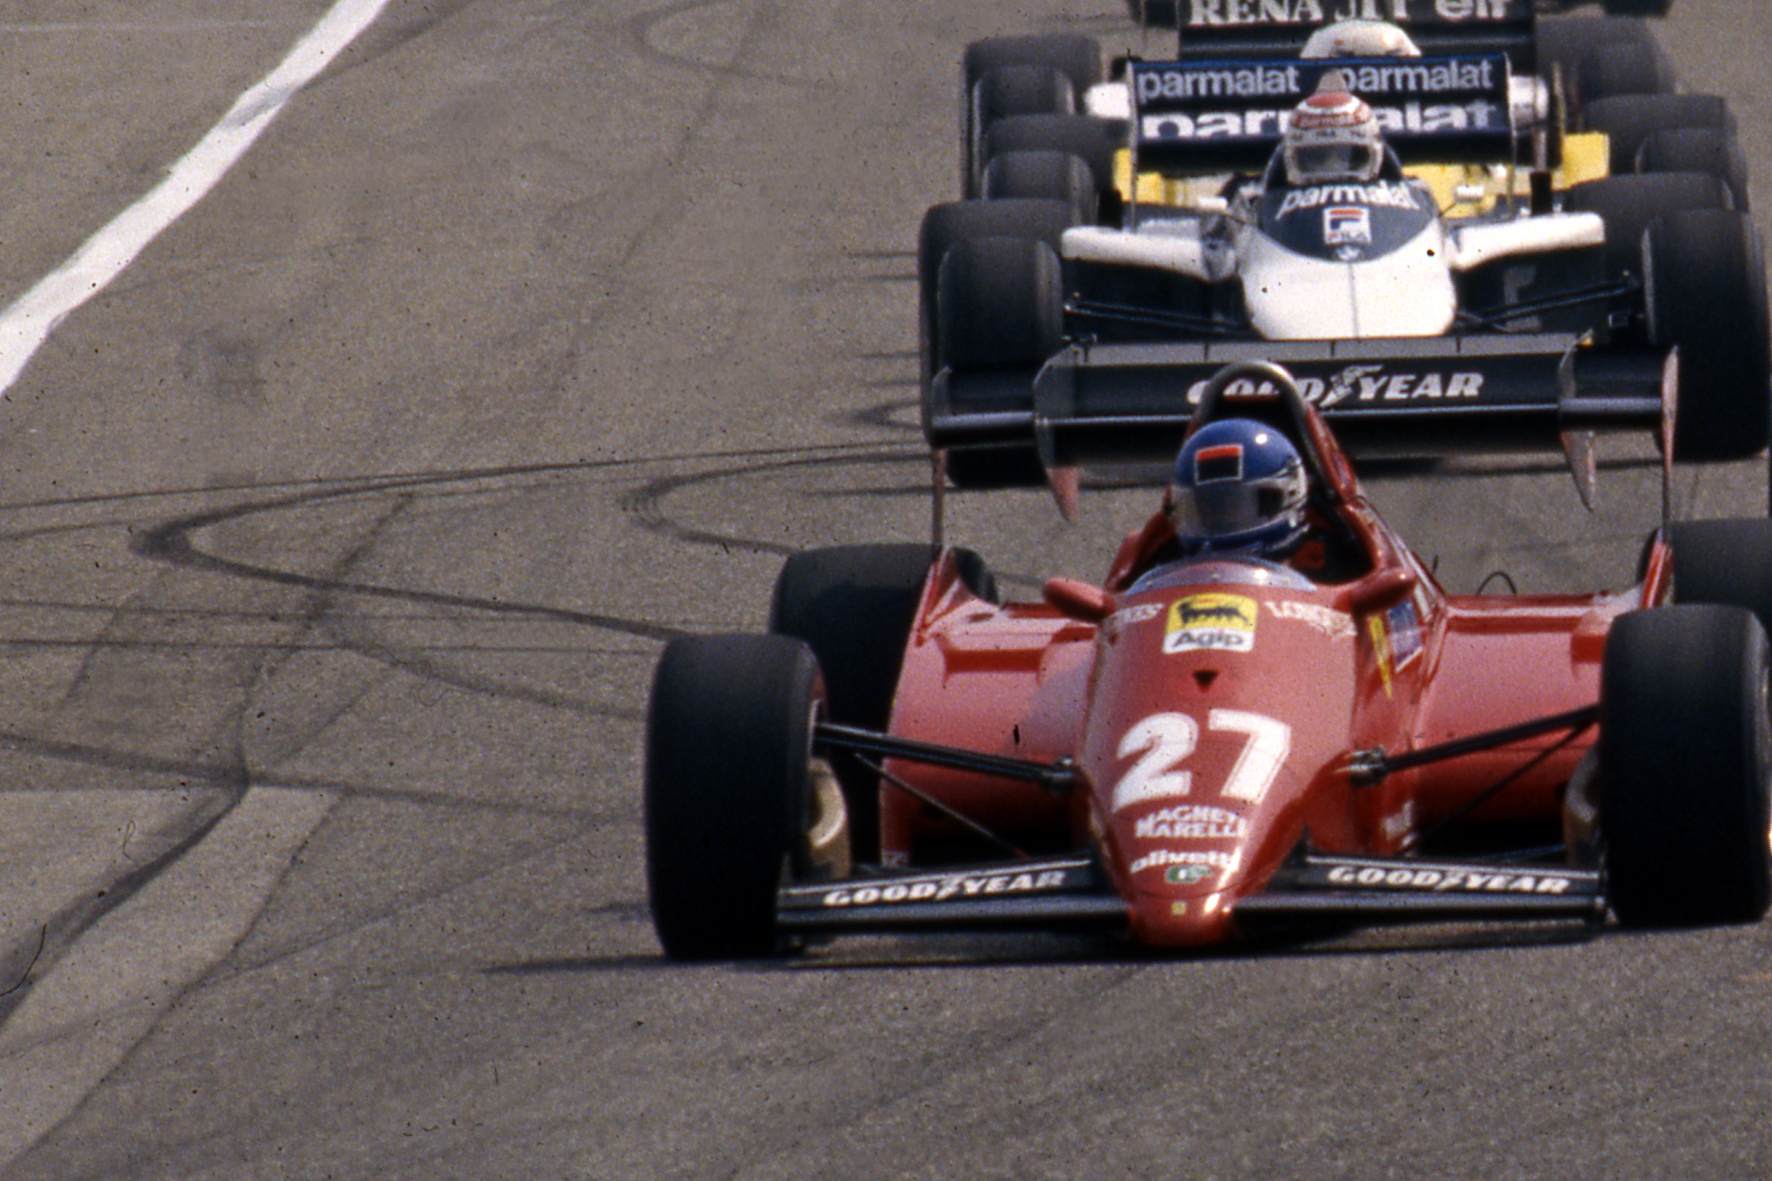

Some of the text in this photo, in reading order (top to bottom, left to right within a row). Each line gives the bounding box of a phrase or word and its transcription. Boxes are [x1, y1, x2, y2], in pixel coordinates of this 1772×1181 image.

[1137, 65, 1300, 104] parmalat
[1142, 101, 1496, 139] paralat
[1275, 179, 1421, 220] parmalat
[1173, 627, 1245, 648] Agip
[1111, 708, 1292, 815] 27
[822, 865, 1571, 907] GOODYEAR GOODYEAR
